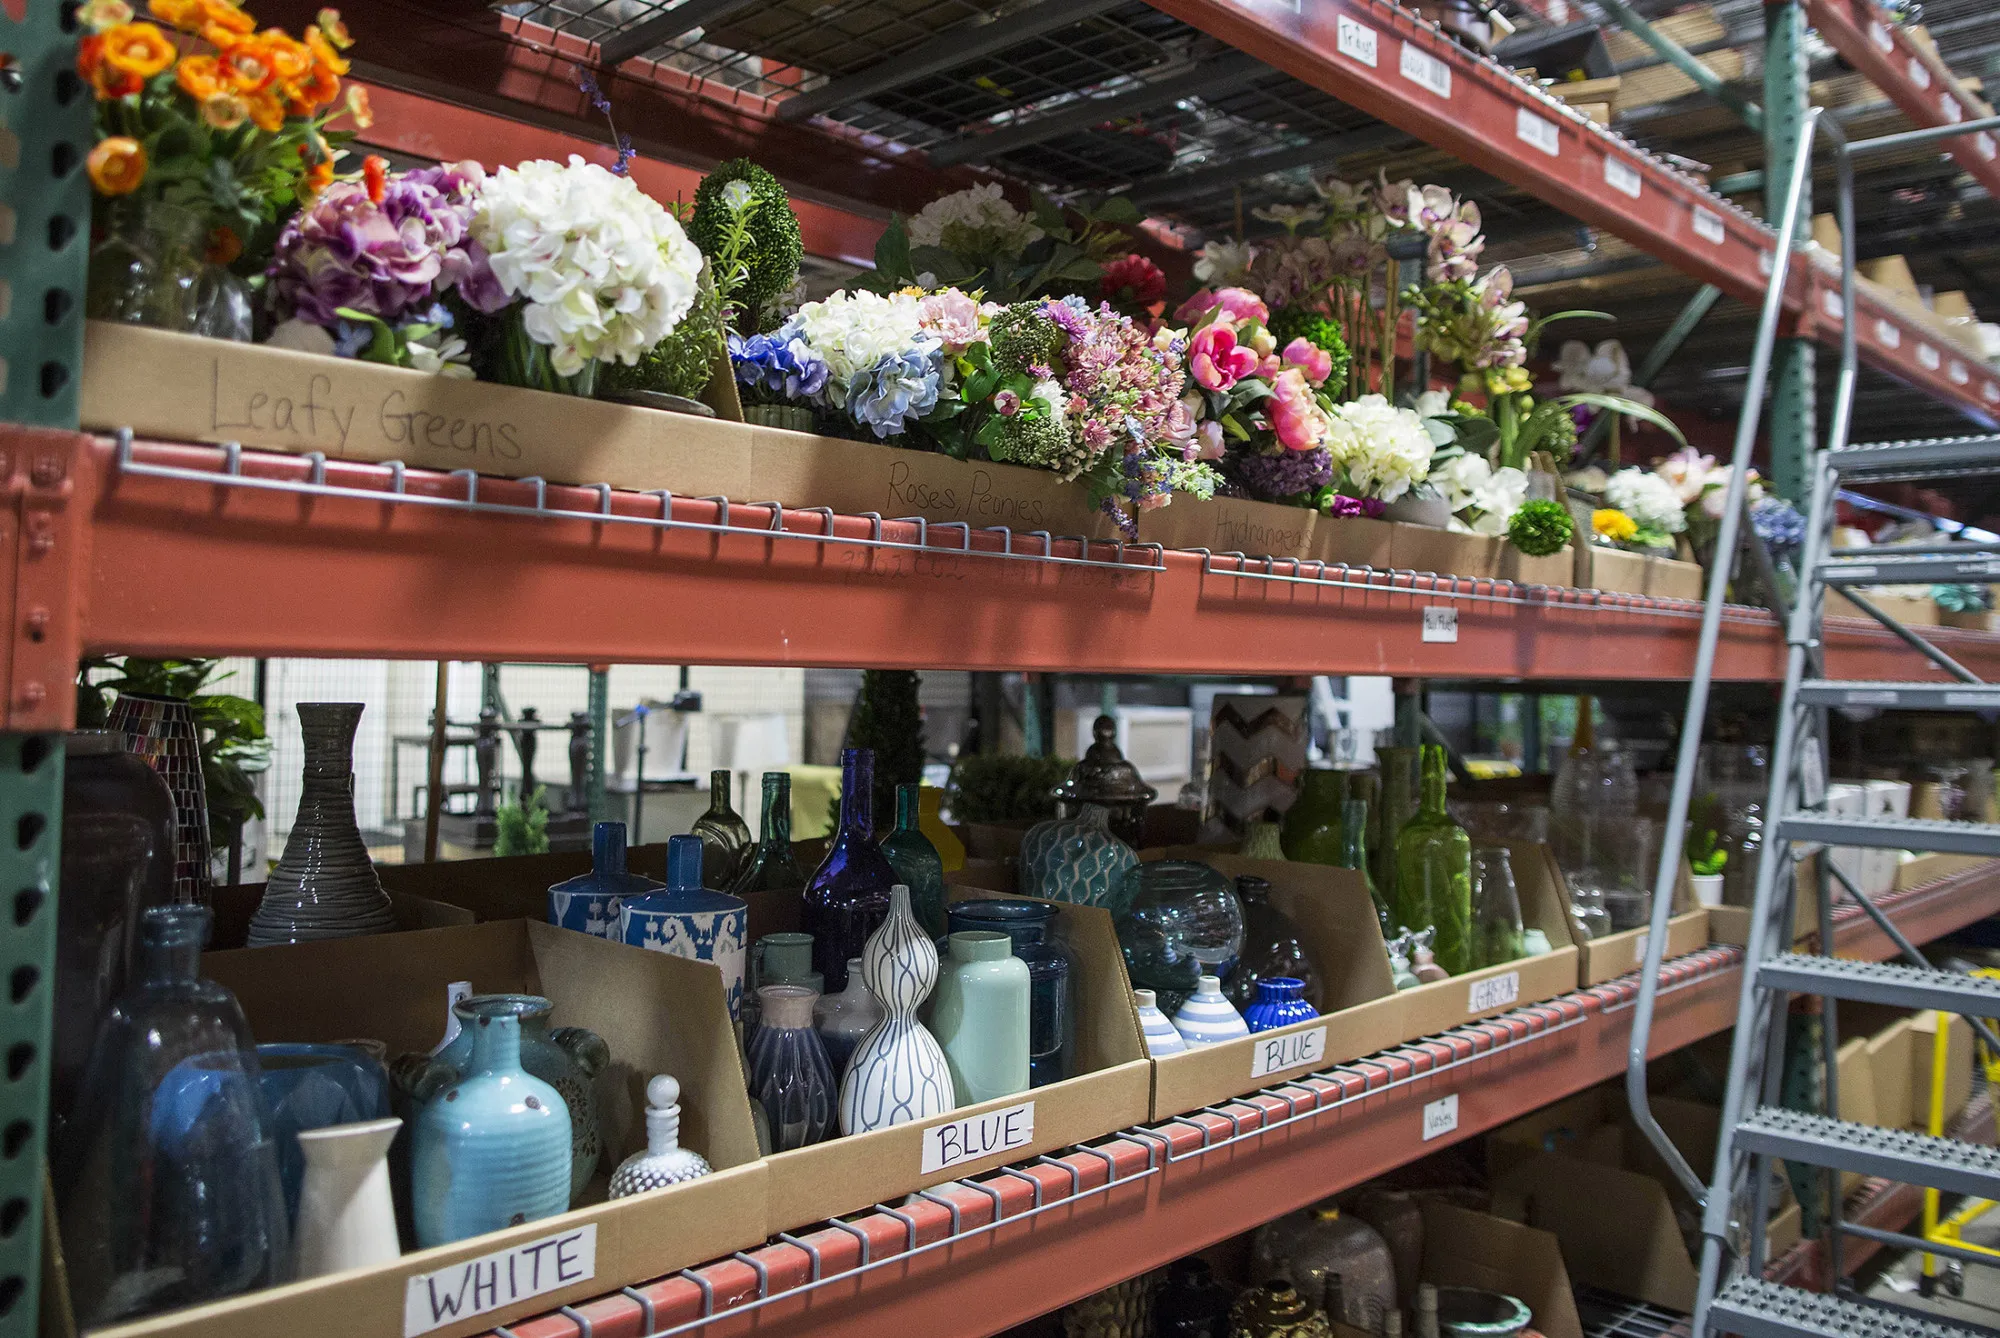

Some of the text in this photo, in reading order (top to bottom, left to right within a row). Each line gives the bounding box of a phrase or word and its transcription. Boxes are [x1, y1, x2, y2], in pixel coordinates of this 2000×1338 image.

[211, 356, 522, 460] Leafy Greens
[886, 461, 962, 518] Roses,
[1265, 1031, 1317, 1073] BLUE
[936, 1108, 1025, 1166] BLUE
[427, 1232, 583, 1324] WHITE
